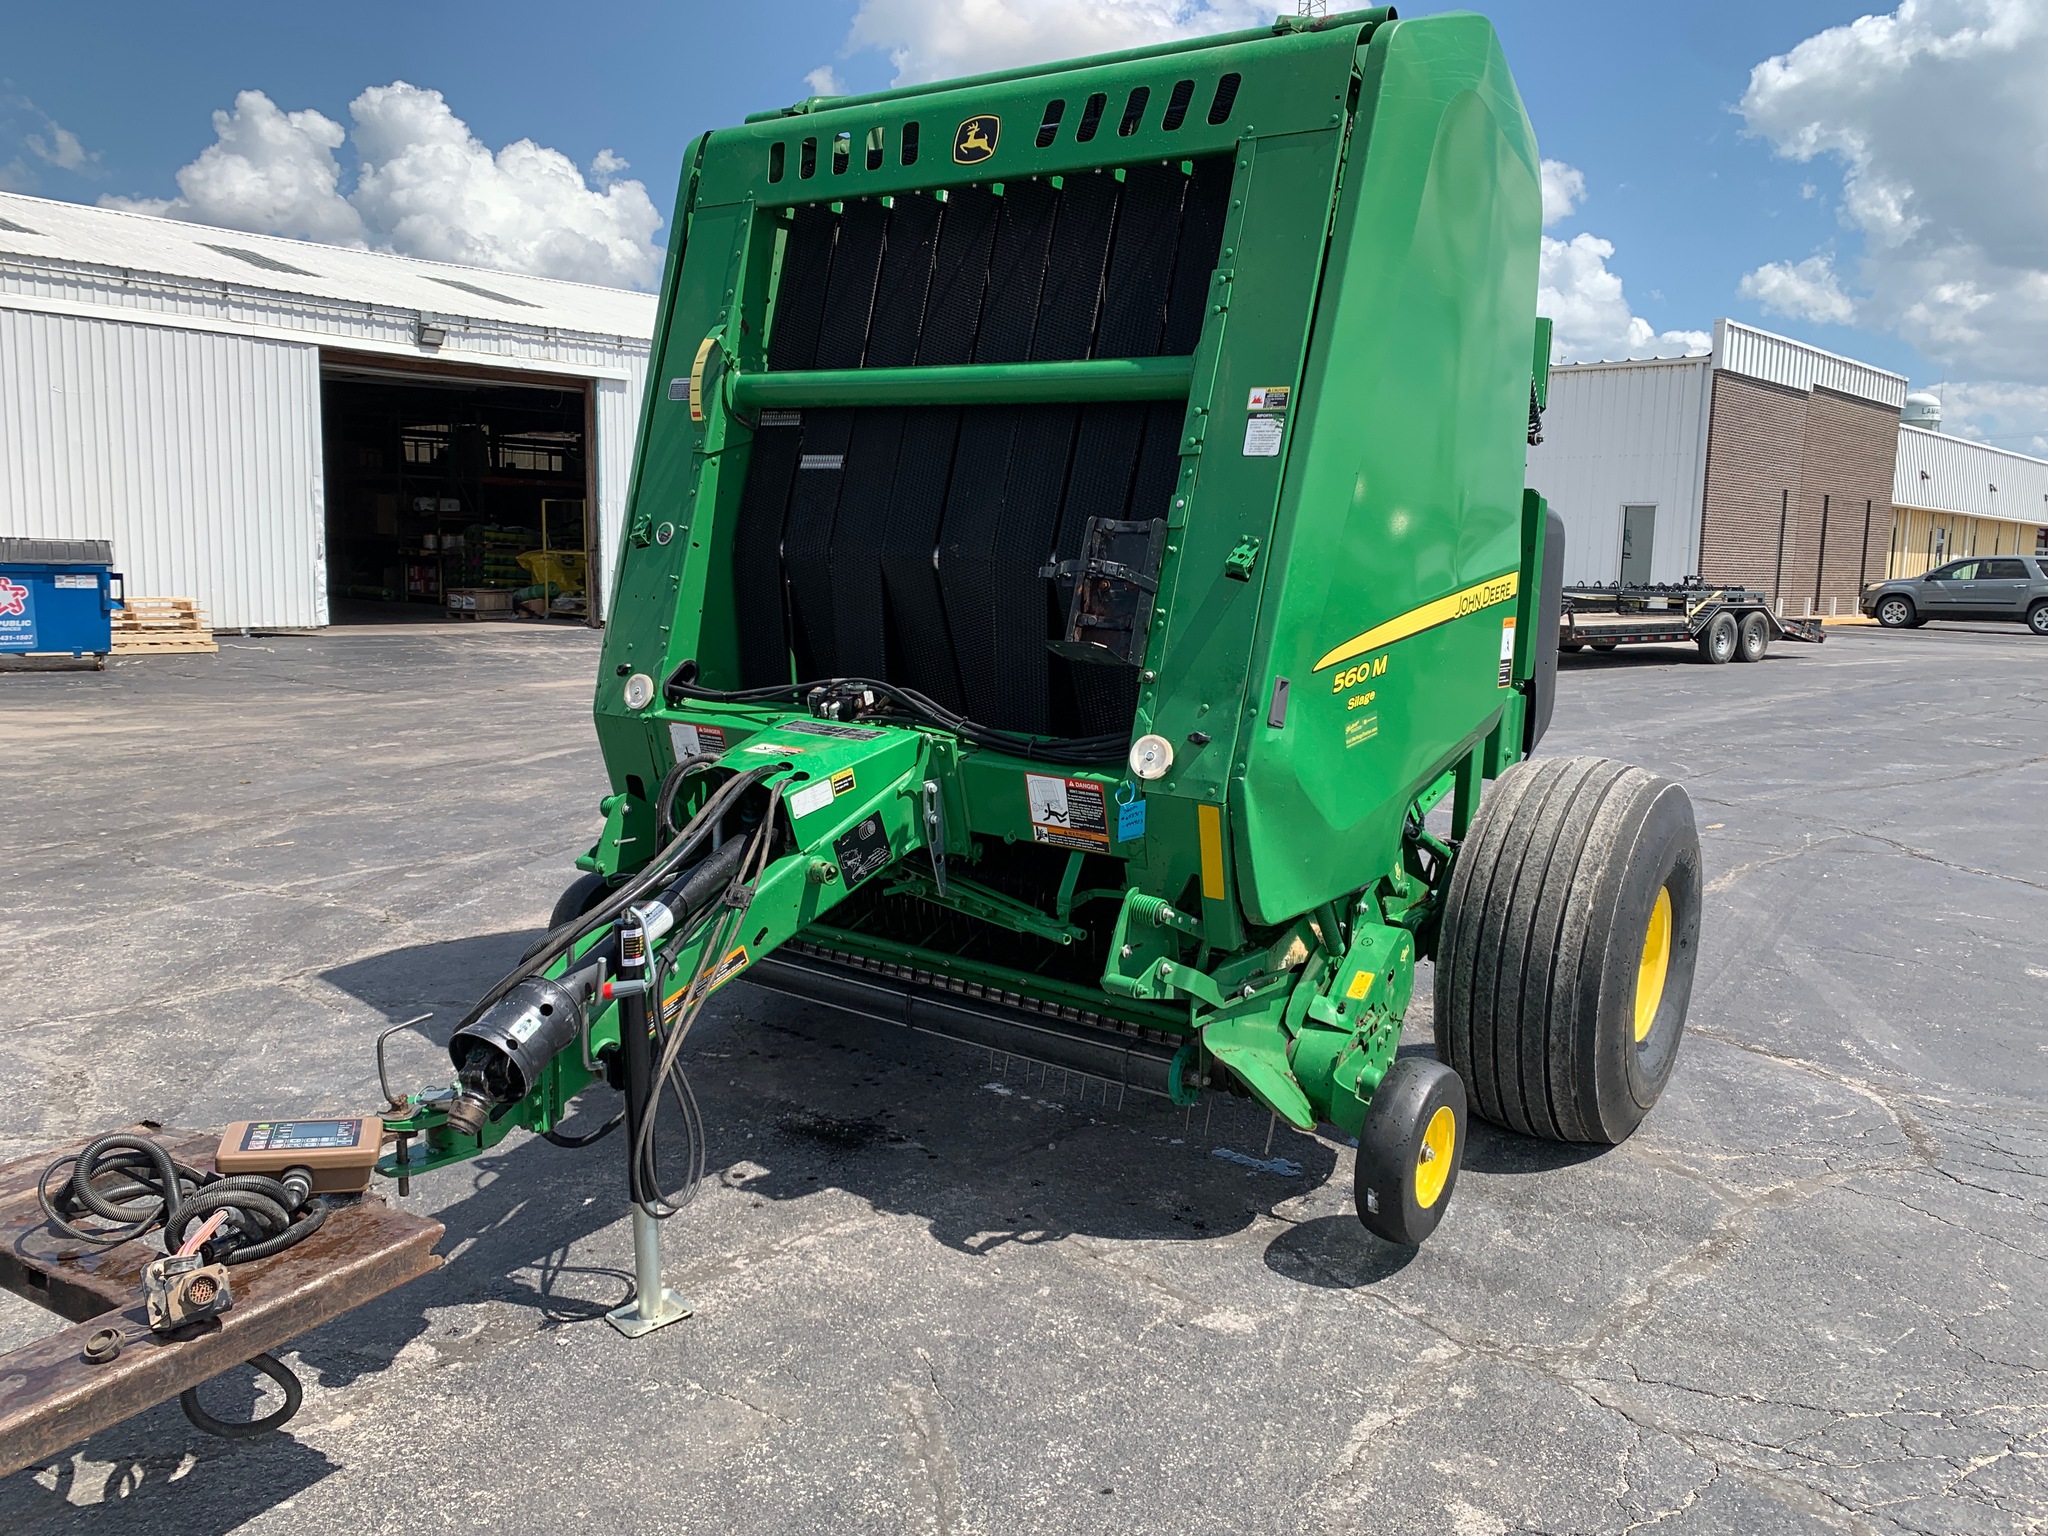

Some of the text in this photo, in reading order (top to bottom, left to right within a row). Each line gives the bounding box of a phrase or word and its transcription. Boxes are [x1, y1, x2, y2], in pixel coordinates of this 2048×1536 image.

[1455, 582, 1511, 615] JOHN DEERE
[1332, 654, 1388, 694] 560 M
[1347, 690, 1375, 711] Silage
[1075, 782, 1099, 790] DANGER
